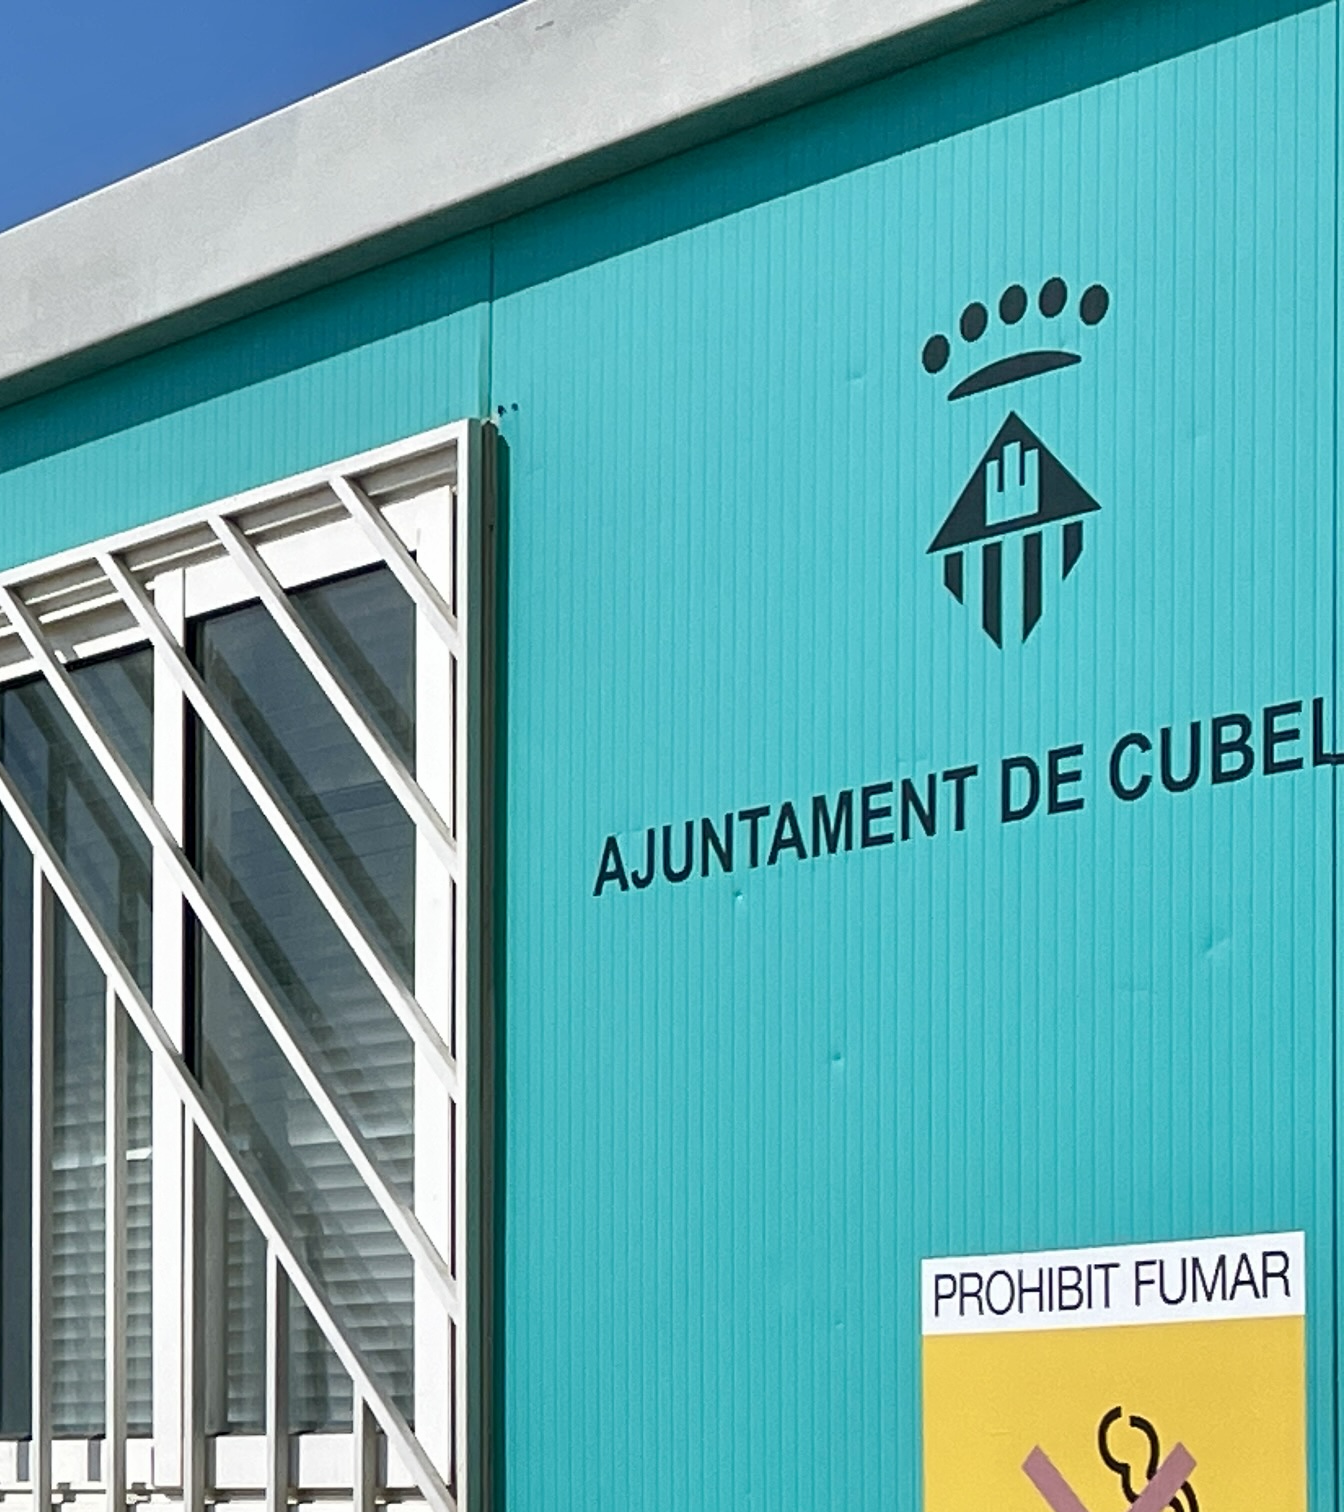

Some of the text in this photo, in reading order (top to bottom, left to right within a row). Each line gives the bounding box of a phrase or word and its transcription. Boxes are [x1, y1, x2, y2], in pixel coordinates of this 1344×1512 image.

[592, 764, 979, 897] AJUNTAMENT
[1000, 743, 1085, 824] DE
[933, 1249, 1292, 1318] PROHIBIT FUMAR
